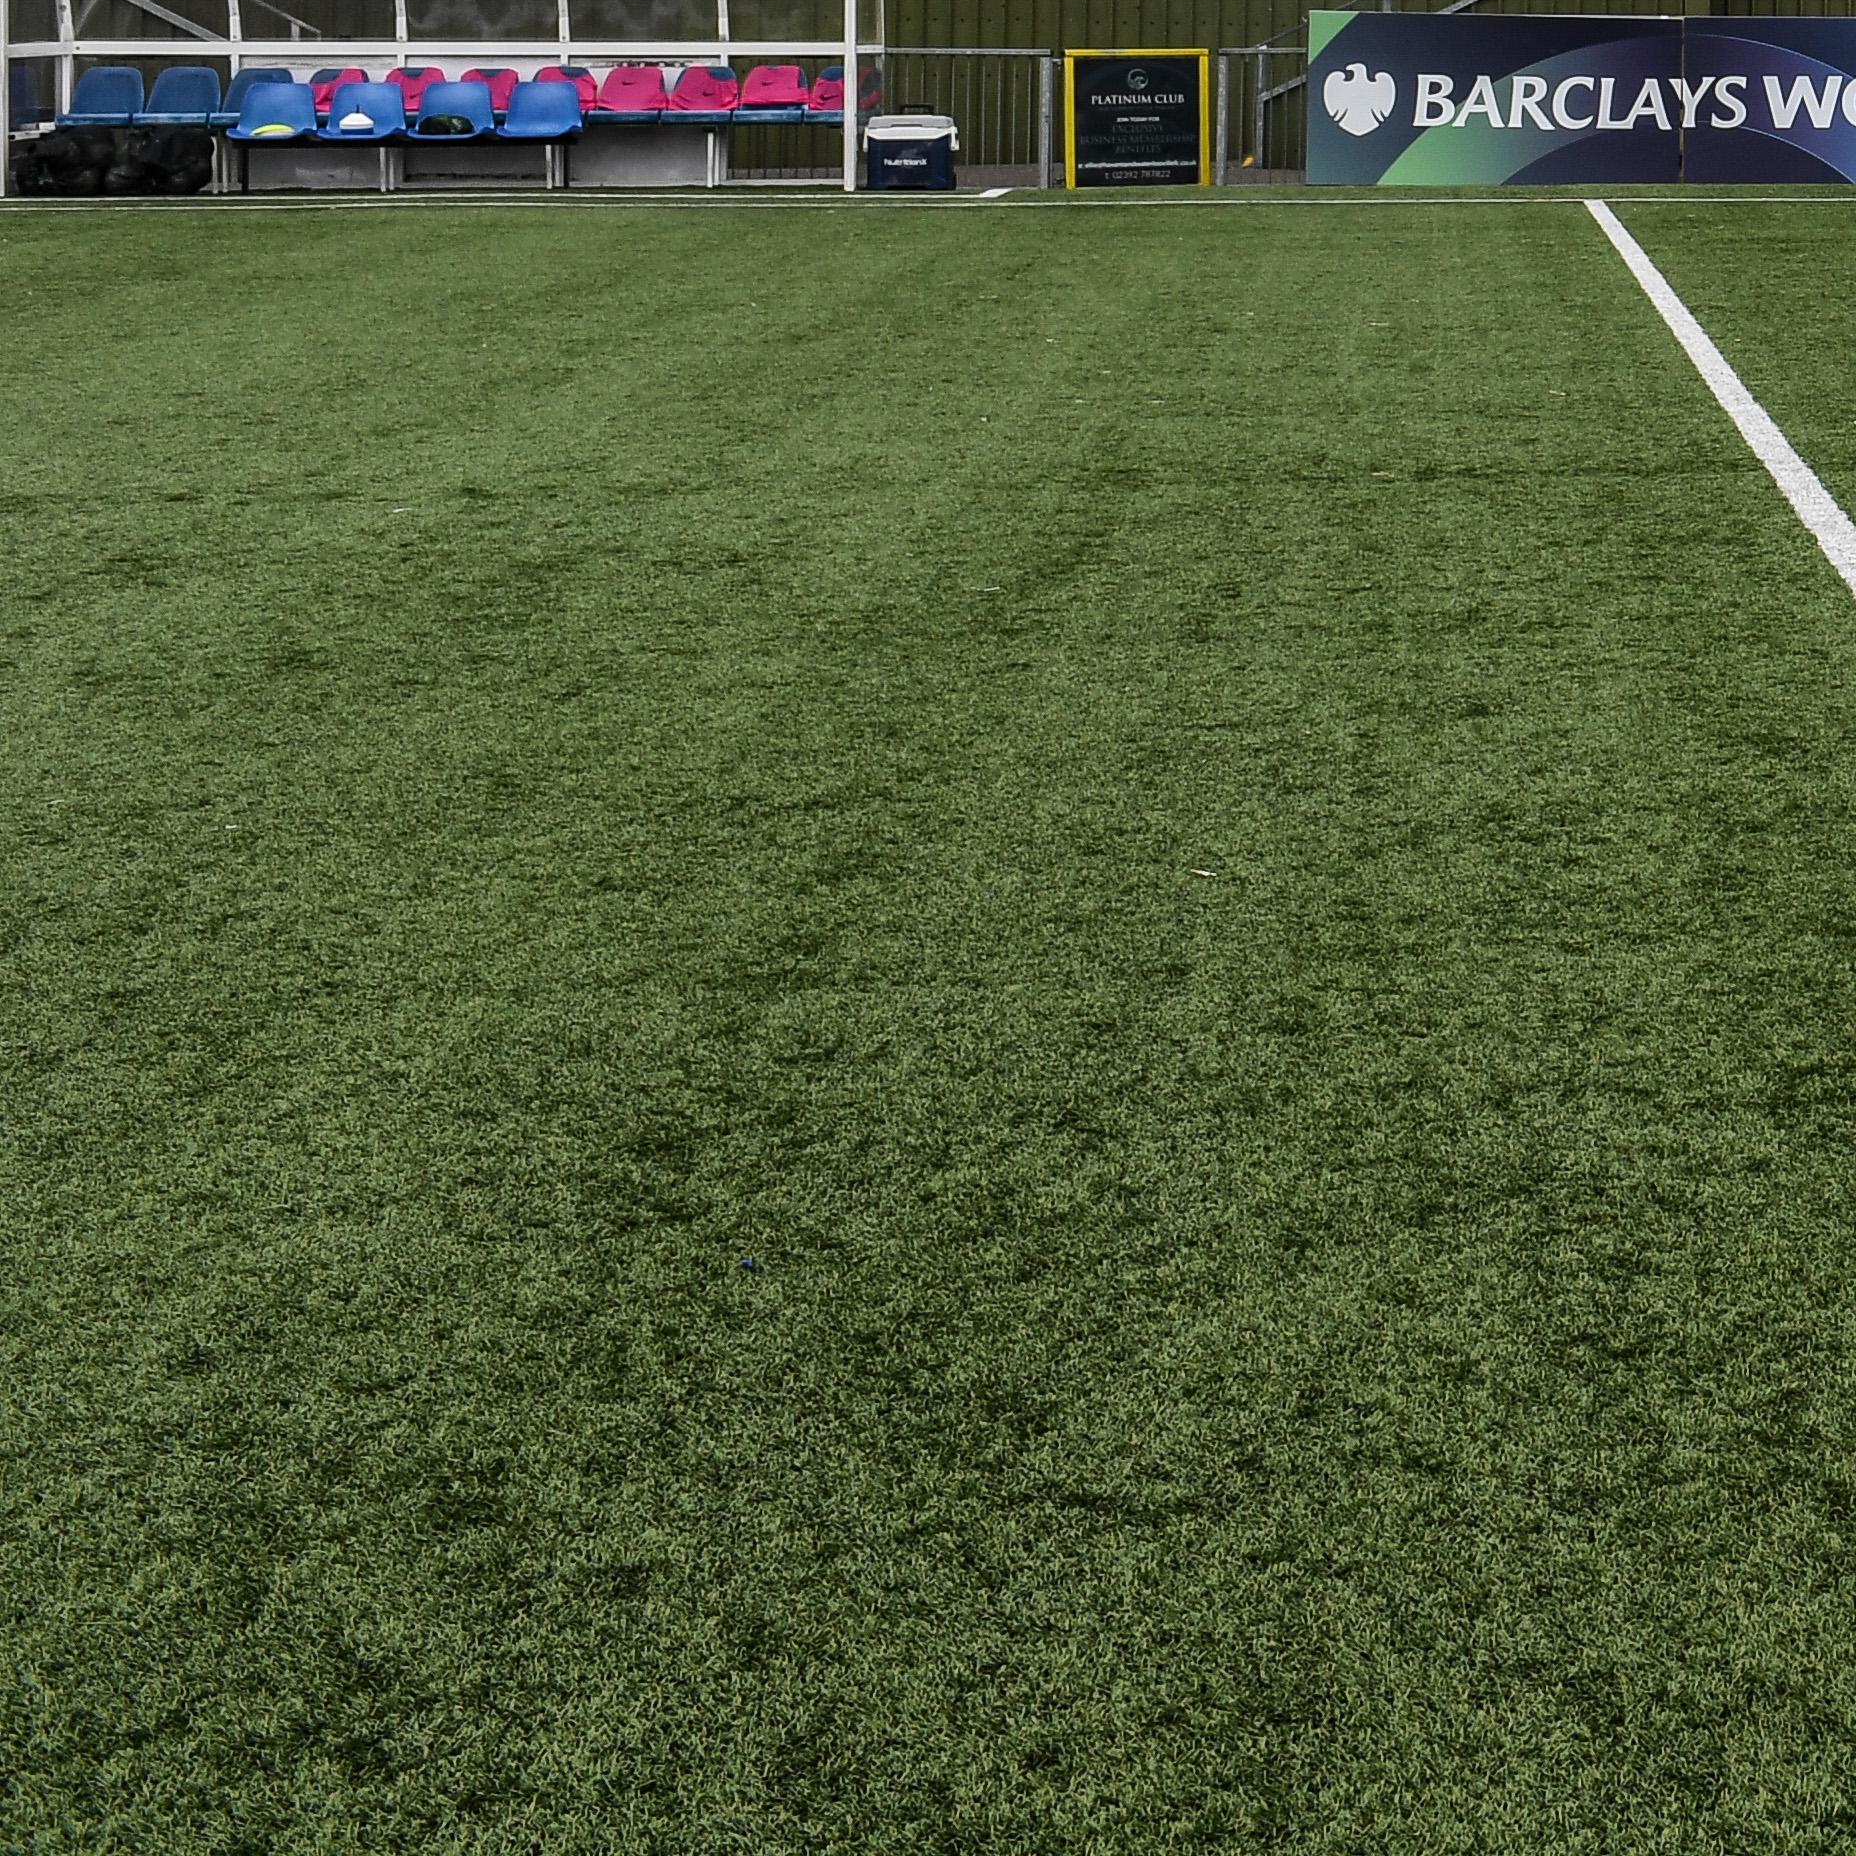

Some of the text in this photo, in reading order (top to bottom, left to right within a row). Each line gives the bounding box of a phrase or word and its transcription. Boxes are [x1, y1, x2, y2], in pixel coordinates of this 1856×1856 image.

[1091, 93, 1185, 105] PLATINUM CLUB
[1412, 73, 1748, 131] BARCLAYS
